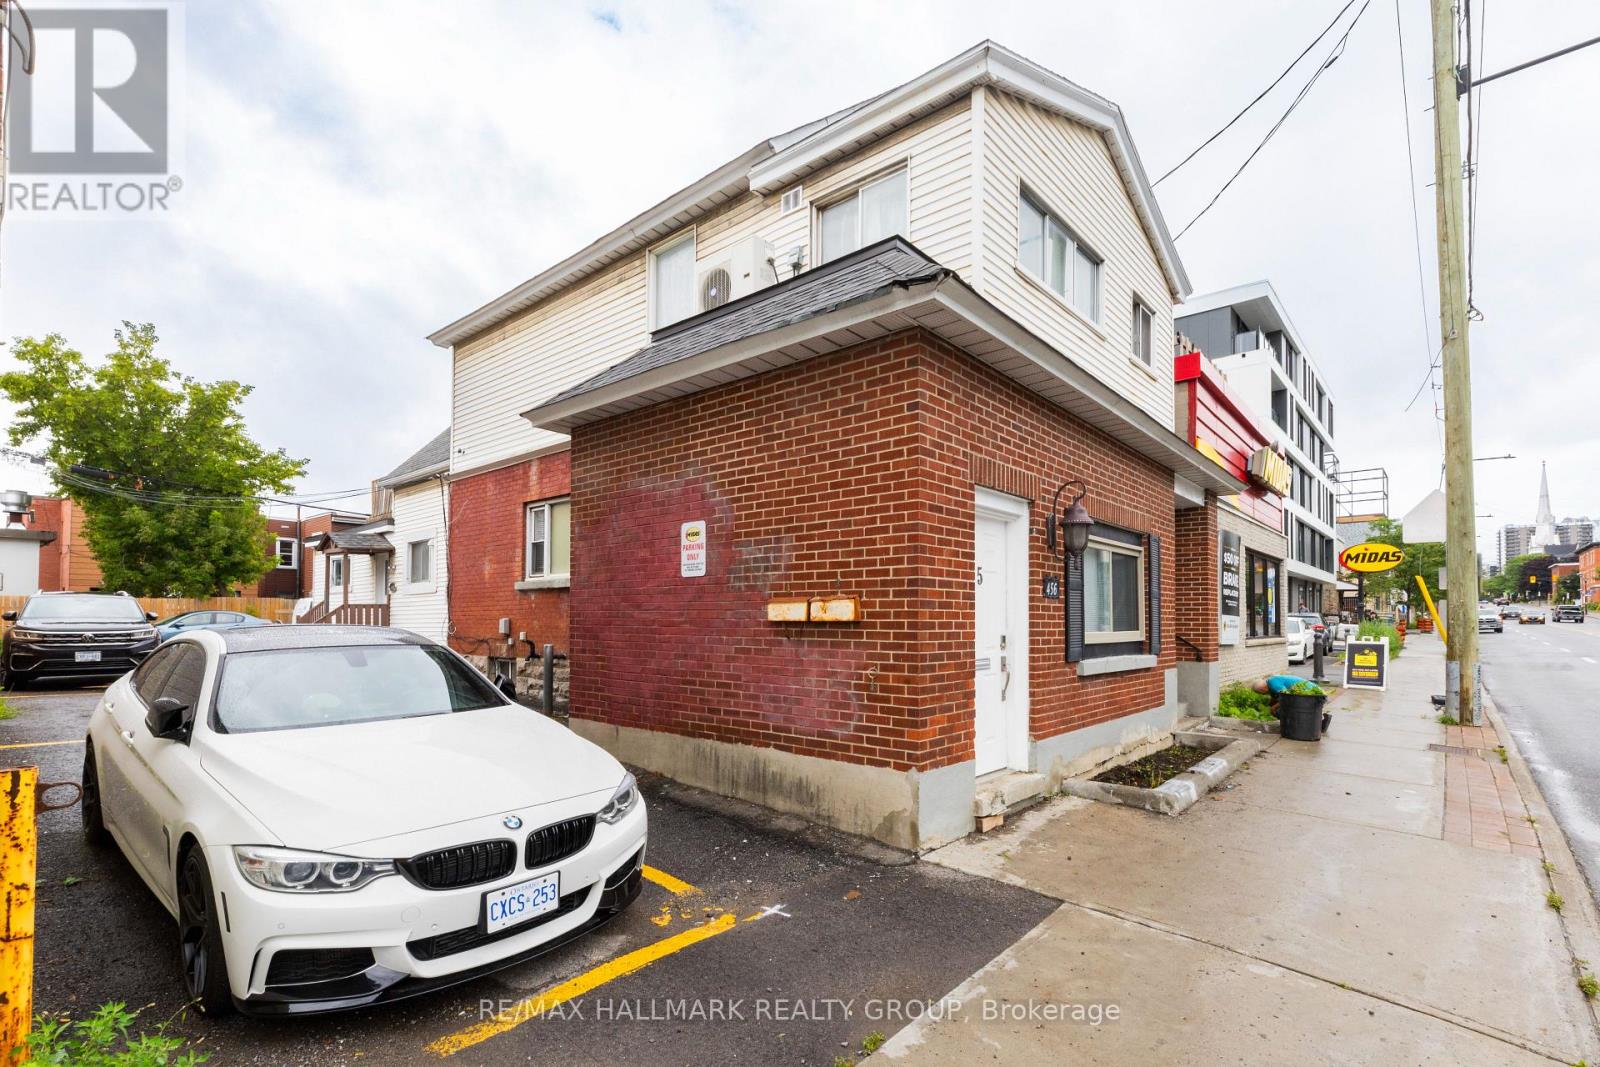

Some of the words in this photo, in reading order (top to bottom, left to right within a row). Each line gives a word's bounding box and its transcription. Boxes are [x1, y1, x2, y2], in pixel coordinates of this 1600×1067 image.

[682, 543, 704, 551] PARKING
[686, 553, 699, 561] ONLY
[1344, 550, 1402, 564] MIDAS
[1046, 582, 1058, 595] 456
[490, 893, 525, 921] CXCS
[532, 883, 556, 907] 253
